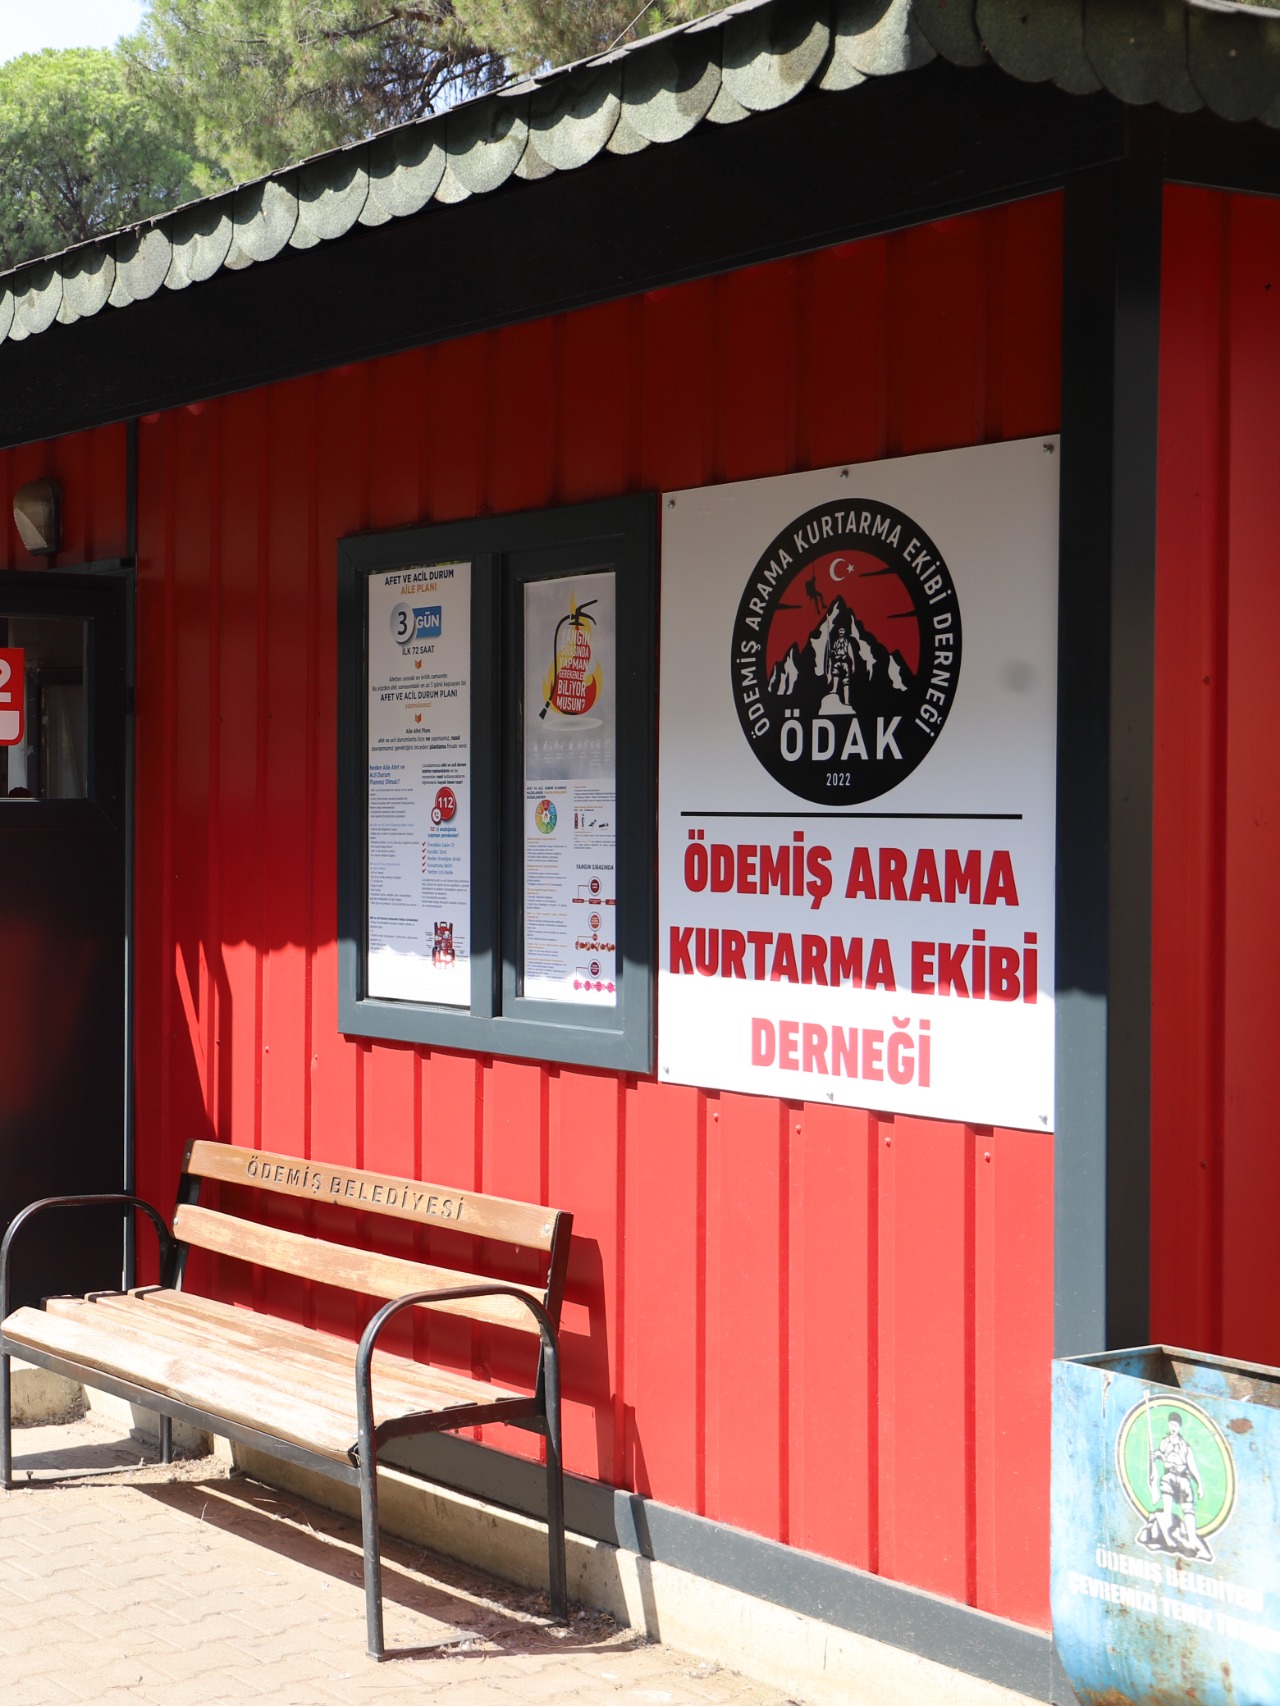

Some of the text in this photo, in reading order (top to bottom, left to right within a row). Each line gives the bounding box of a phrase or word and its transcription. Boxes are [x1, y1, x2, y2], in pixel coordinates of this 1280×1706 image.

[384, 568, 454, 586] AFET VE ACİL DURUM
[397, 611, 408, 635] 3
[416, 611, 439, 628] GÜN
[735, 510, 955, 740] ÖDEMİŞ ARAMA KURTARMA EKİBİ DERNEĞİ
[412, 646, 419, 654] 72
[420, 645, 435, 654] SAAT
[380, 693, 395, 701] AFET
[404, 691, 417, 700] ACİL
[418, 690, 439, 699] DURUM
[440, 689, 458, 697] PLANI
[558, 680, 586, 697] BİLİYOR
[556, 696, 586, 712] MUSUN?
[780, 708, 904, 762] ÖDAK
[826, 772, 851, 786] 2022
[438, 796, 454, 808] 112
[684, 829, 1020, 910] ÖDEMİŞ ARAMA
[669, 925, 1038, 1005] KURTARMA EKİBİ
[751, 1015, 931, 1088] DERNEĞİ
[246, 1154, 465, 1221] ÖDEMİŞ BELEDİYESİ
